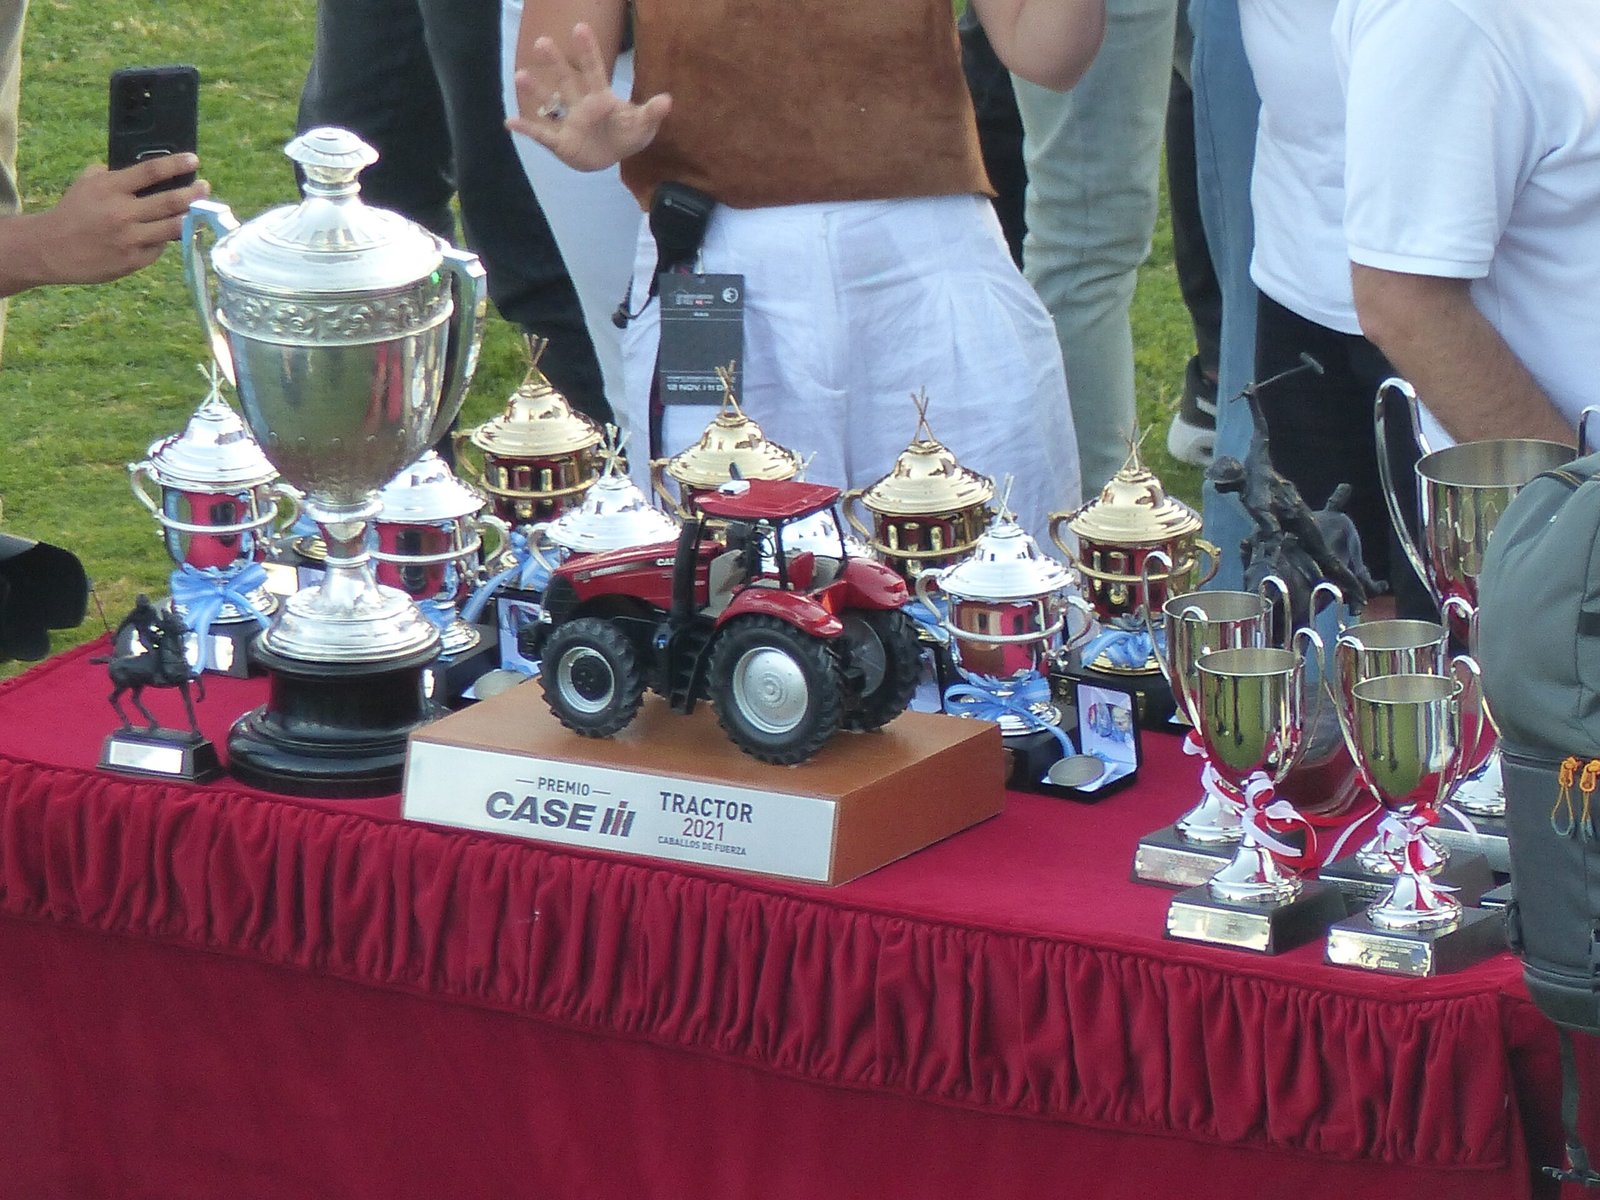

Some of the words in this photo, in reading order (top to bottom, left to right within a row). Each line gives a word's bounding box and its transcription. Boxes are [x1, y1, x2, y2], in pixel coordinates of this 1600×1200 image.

[656, 557, 676, 567] CAS
[538, 776, 590, 796] PREMIO
[486, 790, 597, 832] CASE
[660, 791, 753, 823] TRACTOR
[682, 817, 724, 841] 2021
[658, 836, 700, 849] CABALLOS
[702, 842, 713, 852] DE
[714, 844, 747, 856] FUERZA
